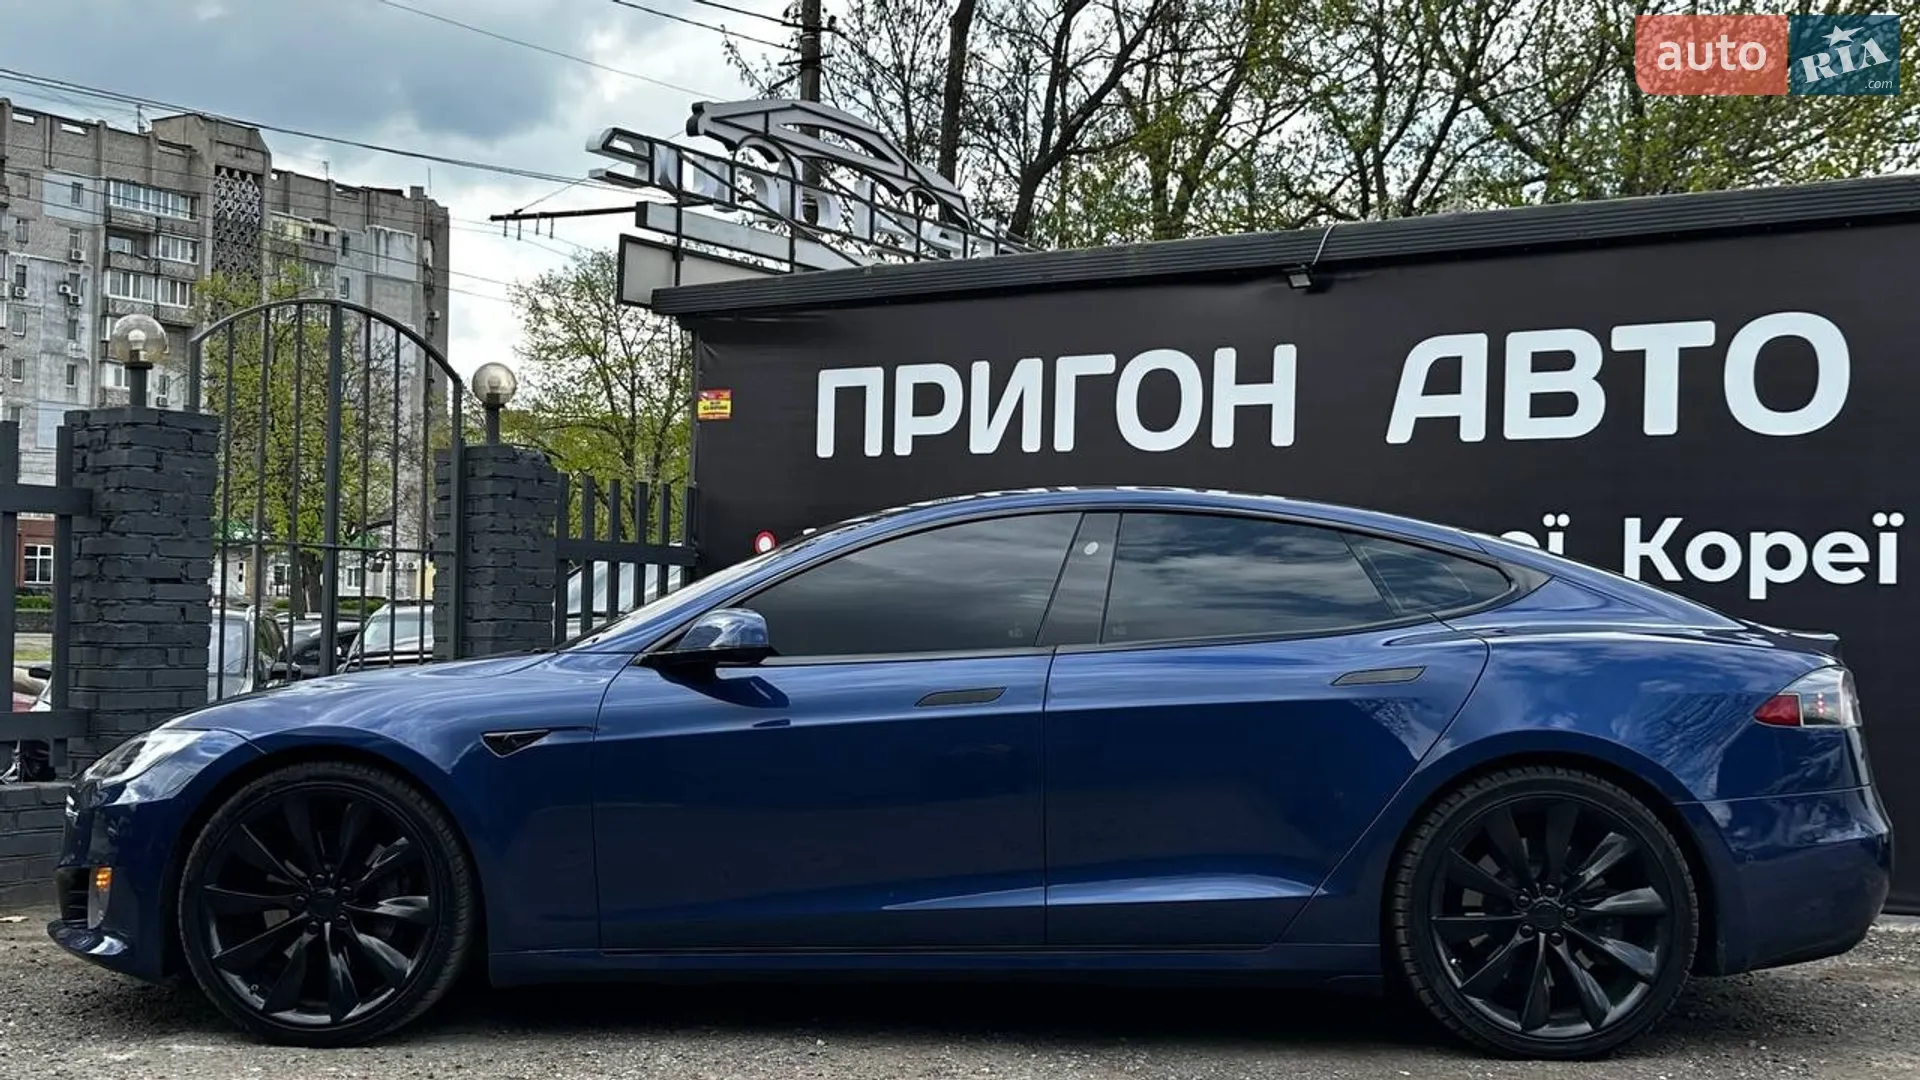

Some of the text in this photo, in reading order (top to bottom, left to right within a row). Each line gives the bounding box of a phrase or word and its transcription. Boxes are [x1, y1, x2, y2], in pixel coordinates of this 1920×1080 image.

[817, 312, 1850, 458] ПРИГОН АВТО
[1623, 513, 1904, 602] Кореї
